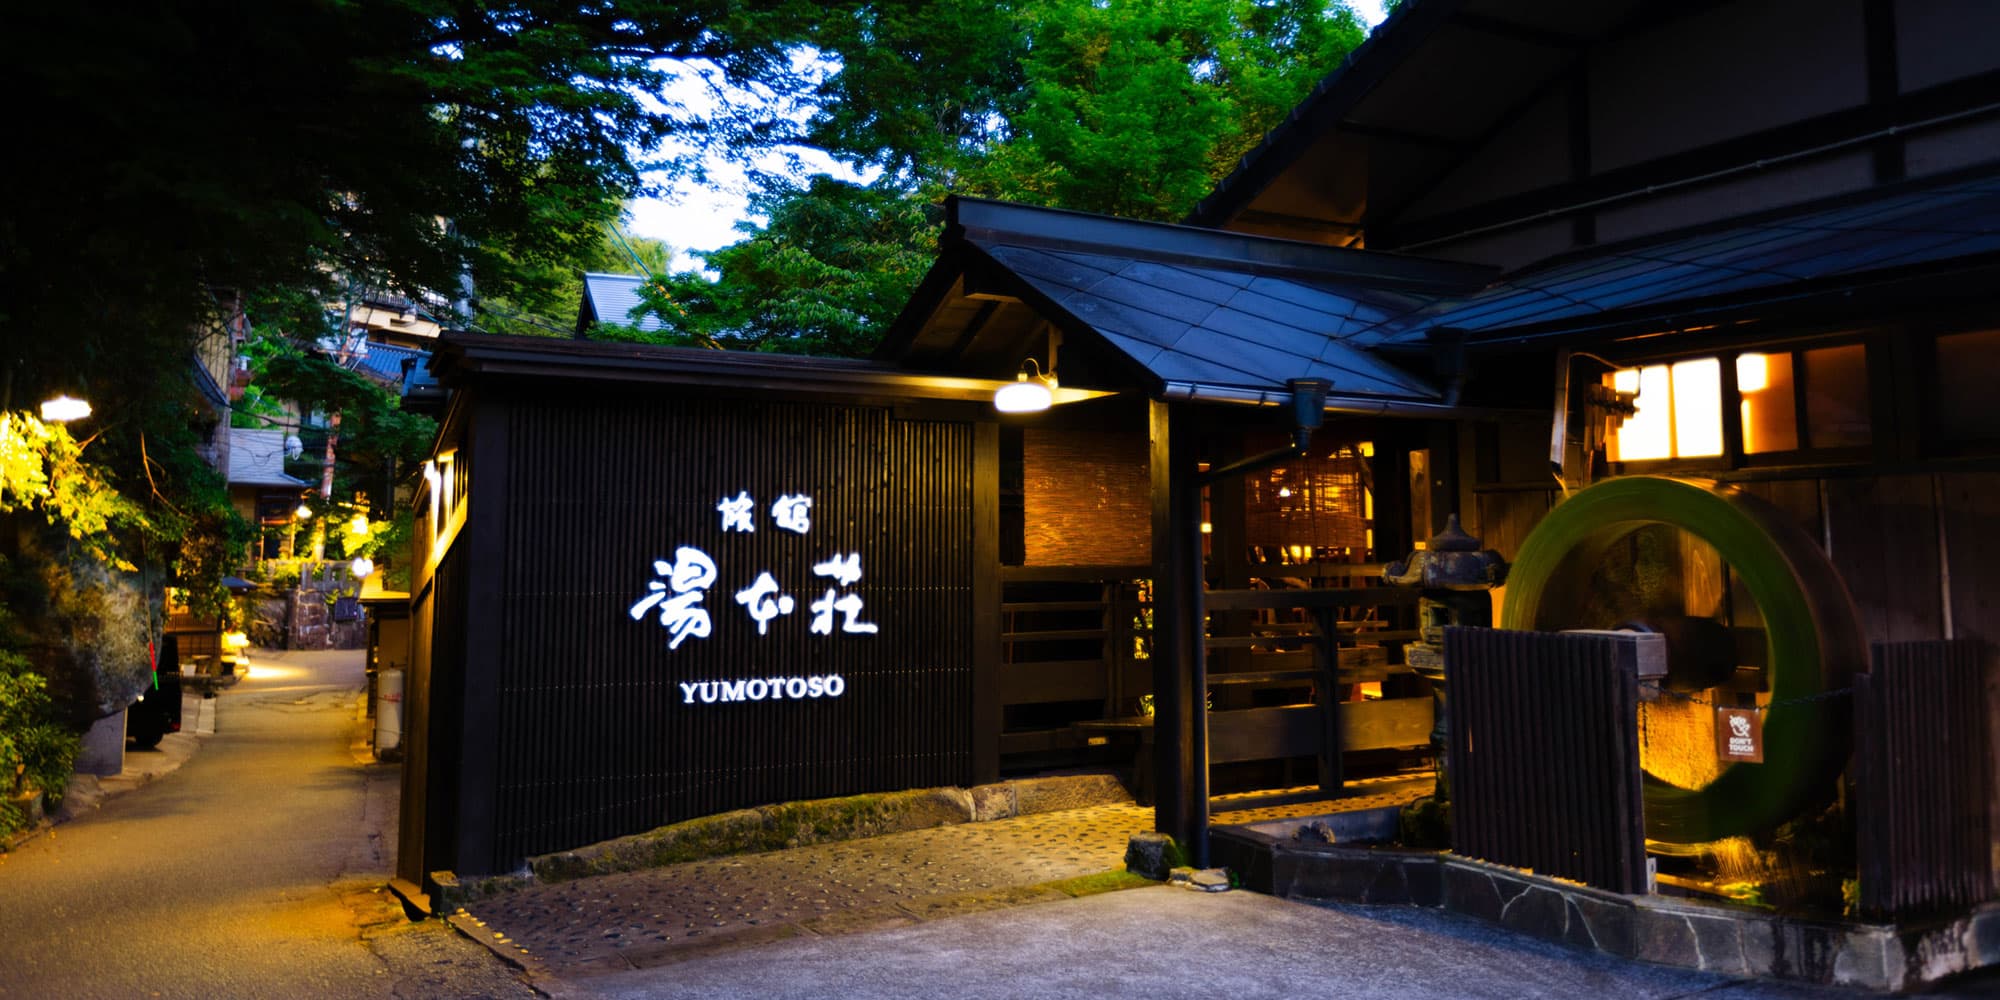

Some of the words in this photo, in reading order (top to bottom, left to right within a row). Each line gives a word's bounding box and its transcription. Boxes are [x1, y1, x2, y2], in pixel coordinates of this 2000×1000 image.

[716, 491, 812, 534] 旅館
[680, 674, 845, 703] YUMOTOSO
[1728, 744, 1754, 752] TOUCH
[1729, 737, 1753, 745] DON'T
